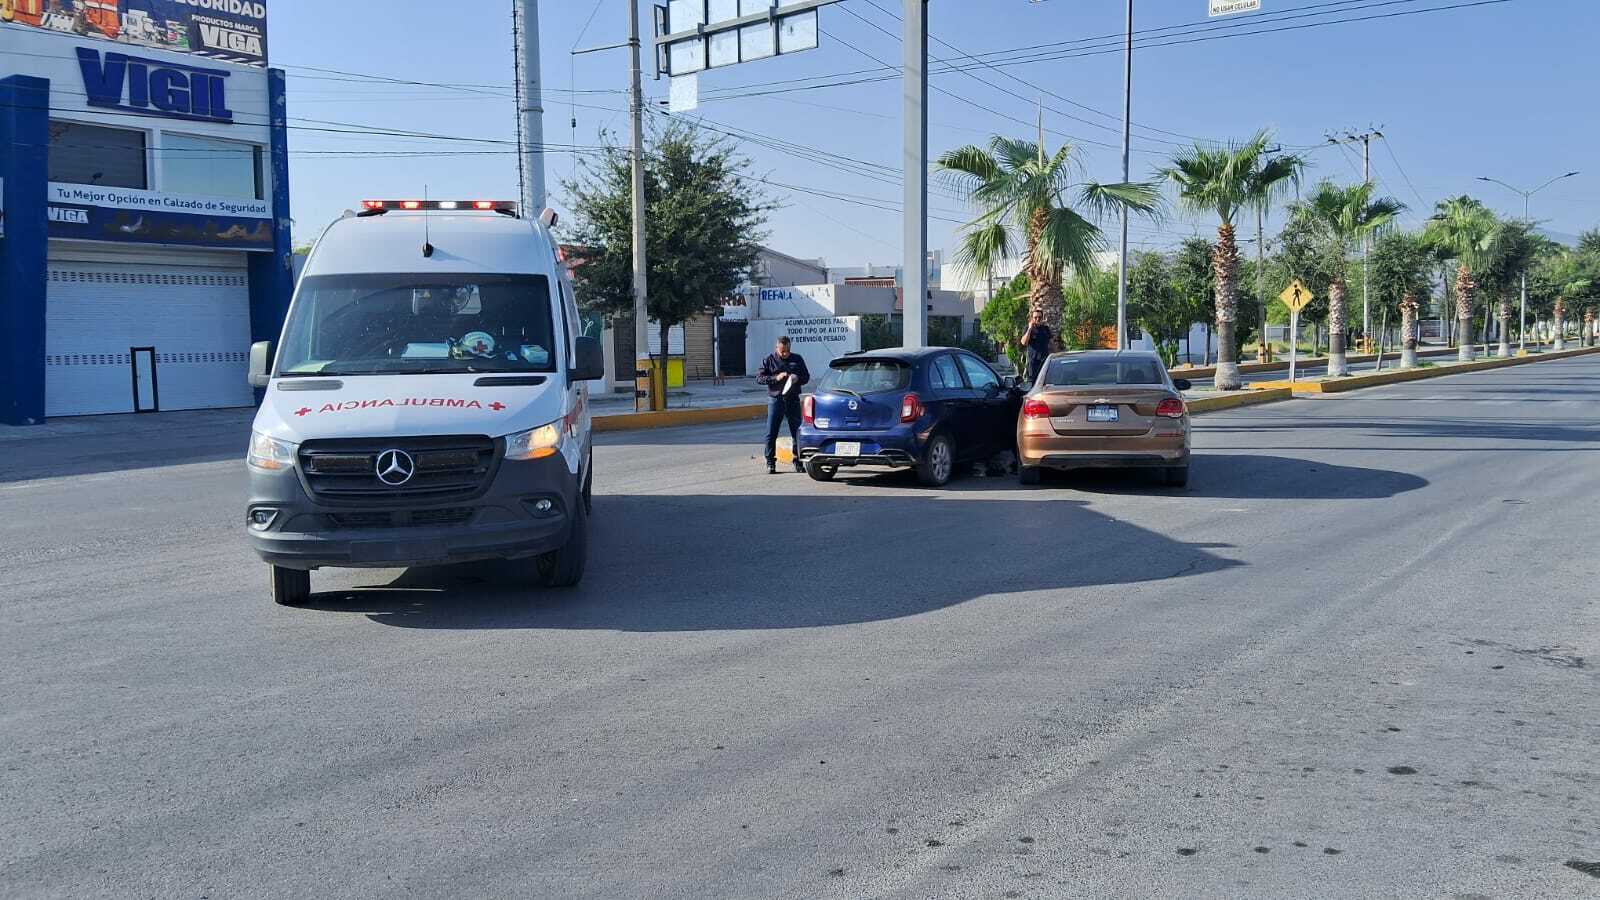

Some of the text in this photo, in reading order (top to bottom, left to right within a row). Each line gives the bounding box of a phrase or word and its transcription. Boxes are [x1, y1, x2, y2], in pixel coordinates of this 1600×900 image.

[191, 14, 259, 33] PRODUCTOS MARCA
[199, 23, 262, 56] VIGA
[76, 46, 233, 124] VIGIL
[57, 188, 267, 214] Tu Mejor Opción en Calzado de Seguridad
[48, 206, 89, 225] VIGA
[785, 318, 832, 326] ACUMULADORES
[795, 335, 823, 343] SERVICIO
